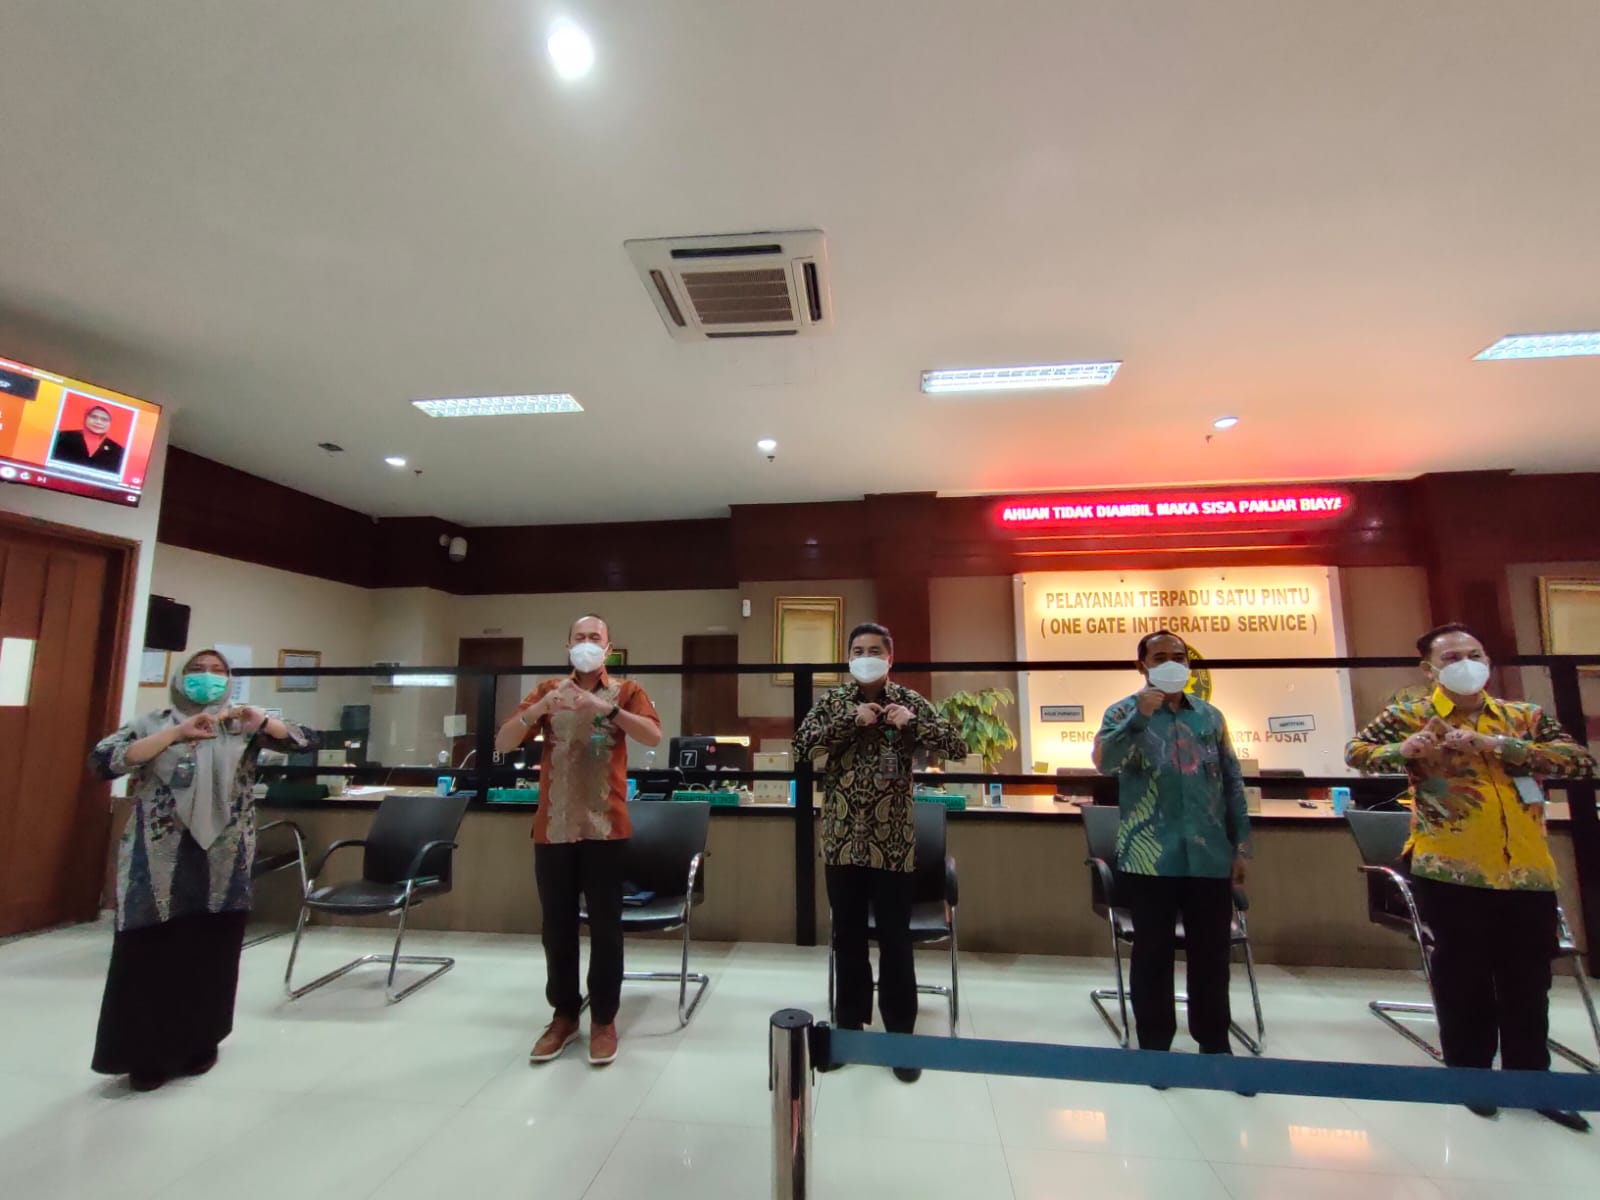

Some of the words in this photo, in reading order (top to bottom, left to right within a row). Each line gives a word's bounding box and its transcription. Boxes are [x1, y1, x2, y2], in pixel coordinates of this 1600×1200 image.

[1003, 507, 1049, 521] AHUAN
[1052, 506, 1093, 519] TIDAK
[1096, 504, 1153, 518] DIAMBIL
[1156, 502, 1199, 516] MAKA
[1201, 501, 1236, 514] SISA
[1239, 499, 1298, 512] PANJAR
[1046, 591, 1134, 609] PELAYANAN
[1138, 589, 1210, 607] TERPADU
[1215, 588, 1256, 606] SATU
[1261, 587, 1310, 605] PINTU
[1086, 617, 1127, 634] GATE
[1132, 615, 1231, 633] INTEGRATED
[1237, 614, 1308, 633] SERVICE
[1265, 731, 1309, 743] PUSAT
[684, 752, 693, 765] 7
